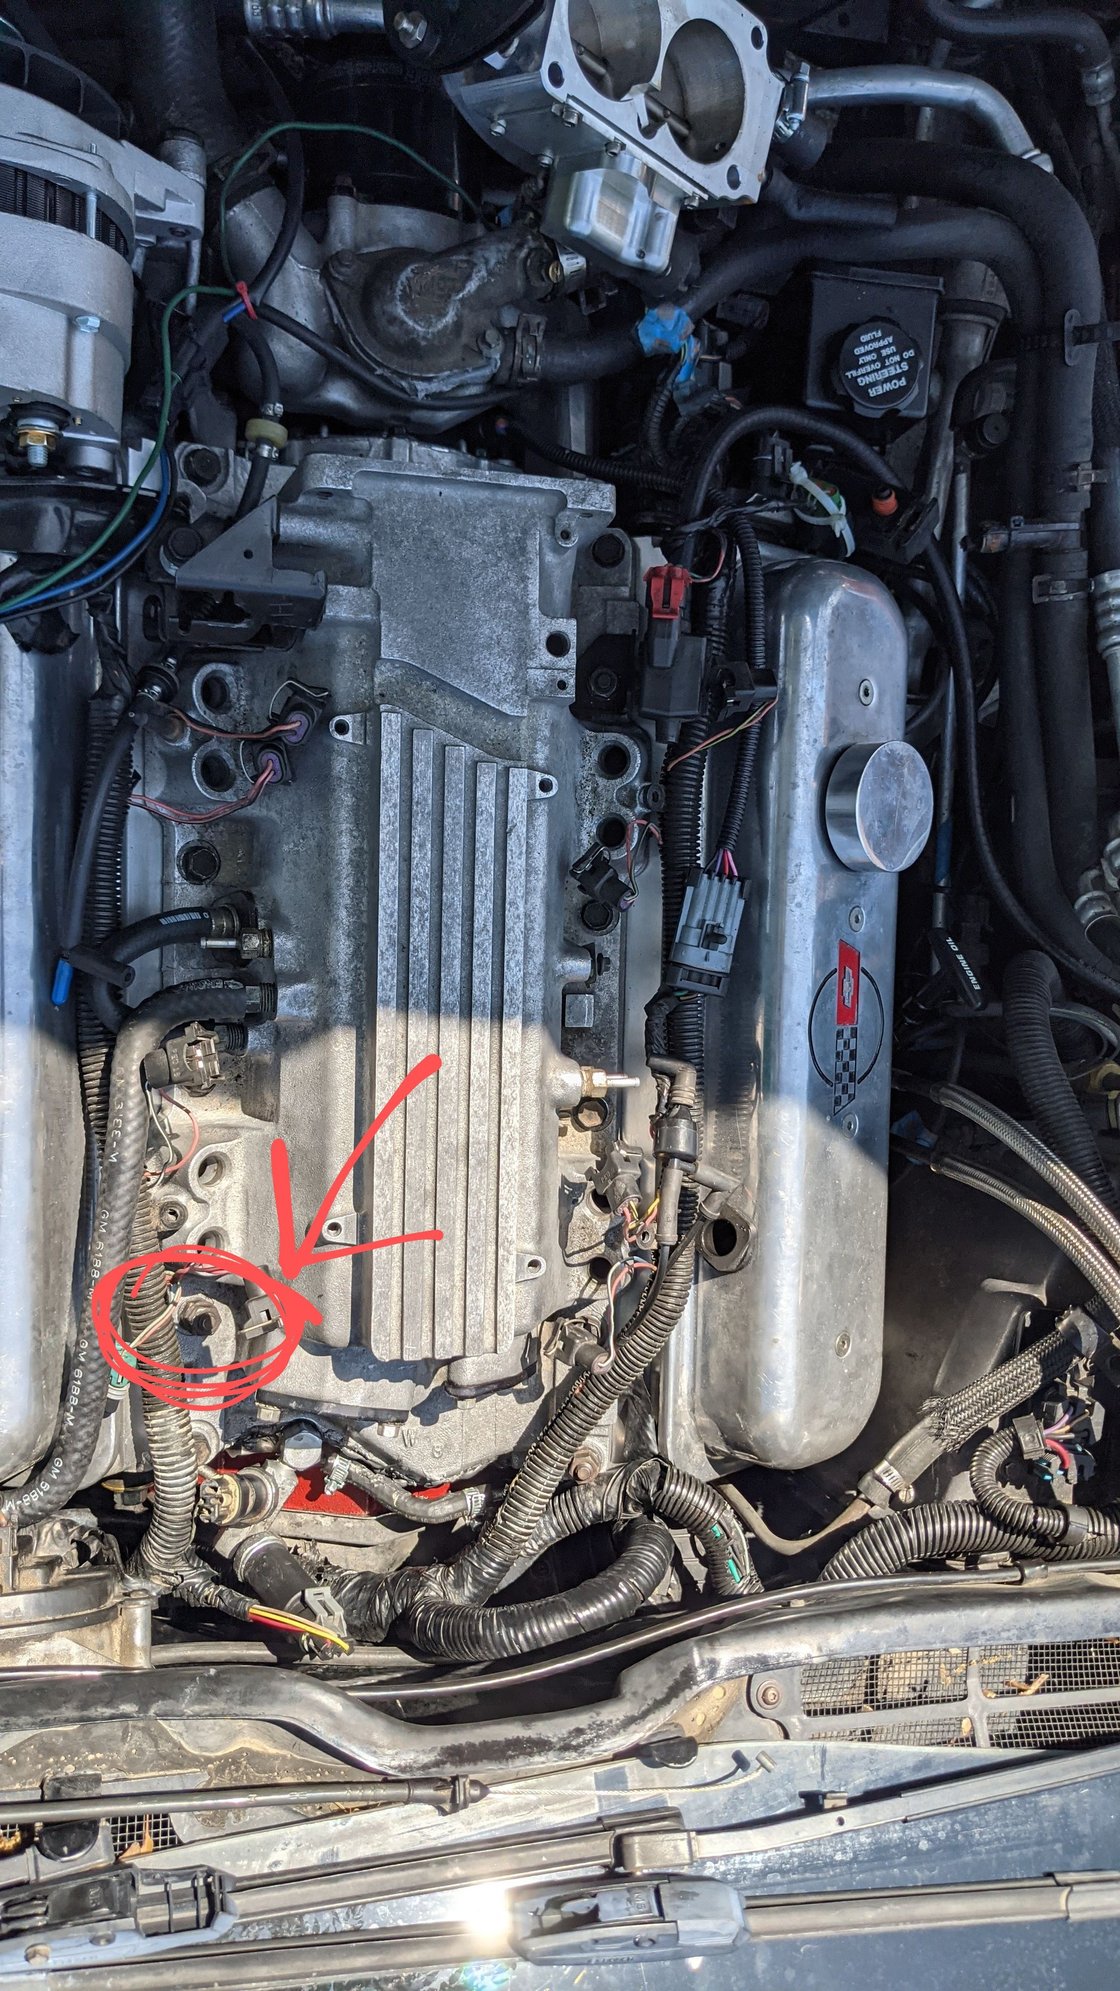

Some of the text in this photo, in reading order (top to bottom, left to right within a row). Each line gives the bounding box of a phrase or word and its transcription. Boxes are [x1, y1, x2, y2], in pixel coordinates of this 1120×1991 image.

[854, 336, 893, 355] APPROVED
[860, 330, 882, 342] FLUID
[845, 349, 915, 379] DO NOT OVERFILL
[859, 346, 896, 364] USE ONLY
[857, 362, 909, 386] STEERING
[868, 377, 907, 397] POWER
[946, 937, 981, 990] ENGINE OIL
[98, 1209, 110, 1233] GM
[64, 1338, 89, 1426] GM 6188-M
[5, 1457, 63, 1511] GM 6188-M
